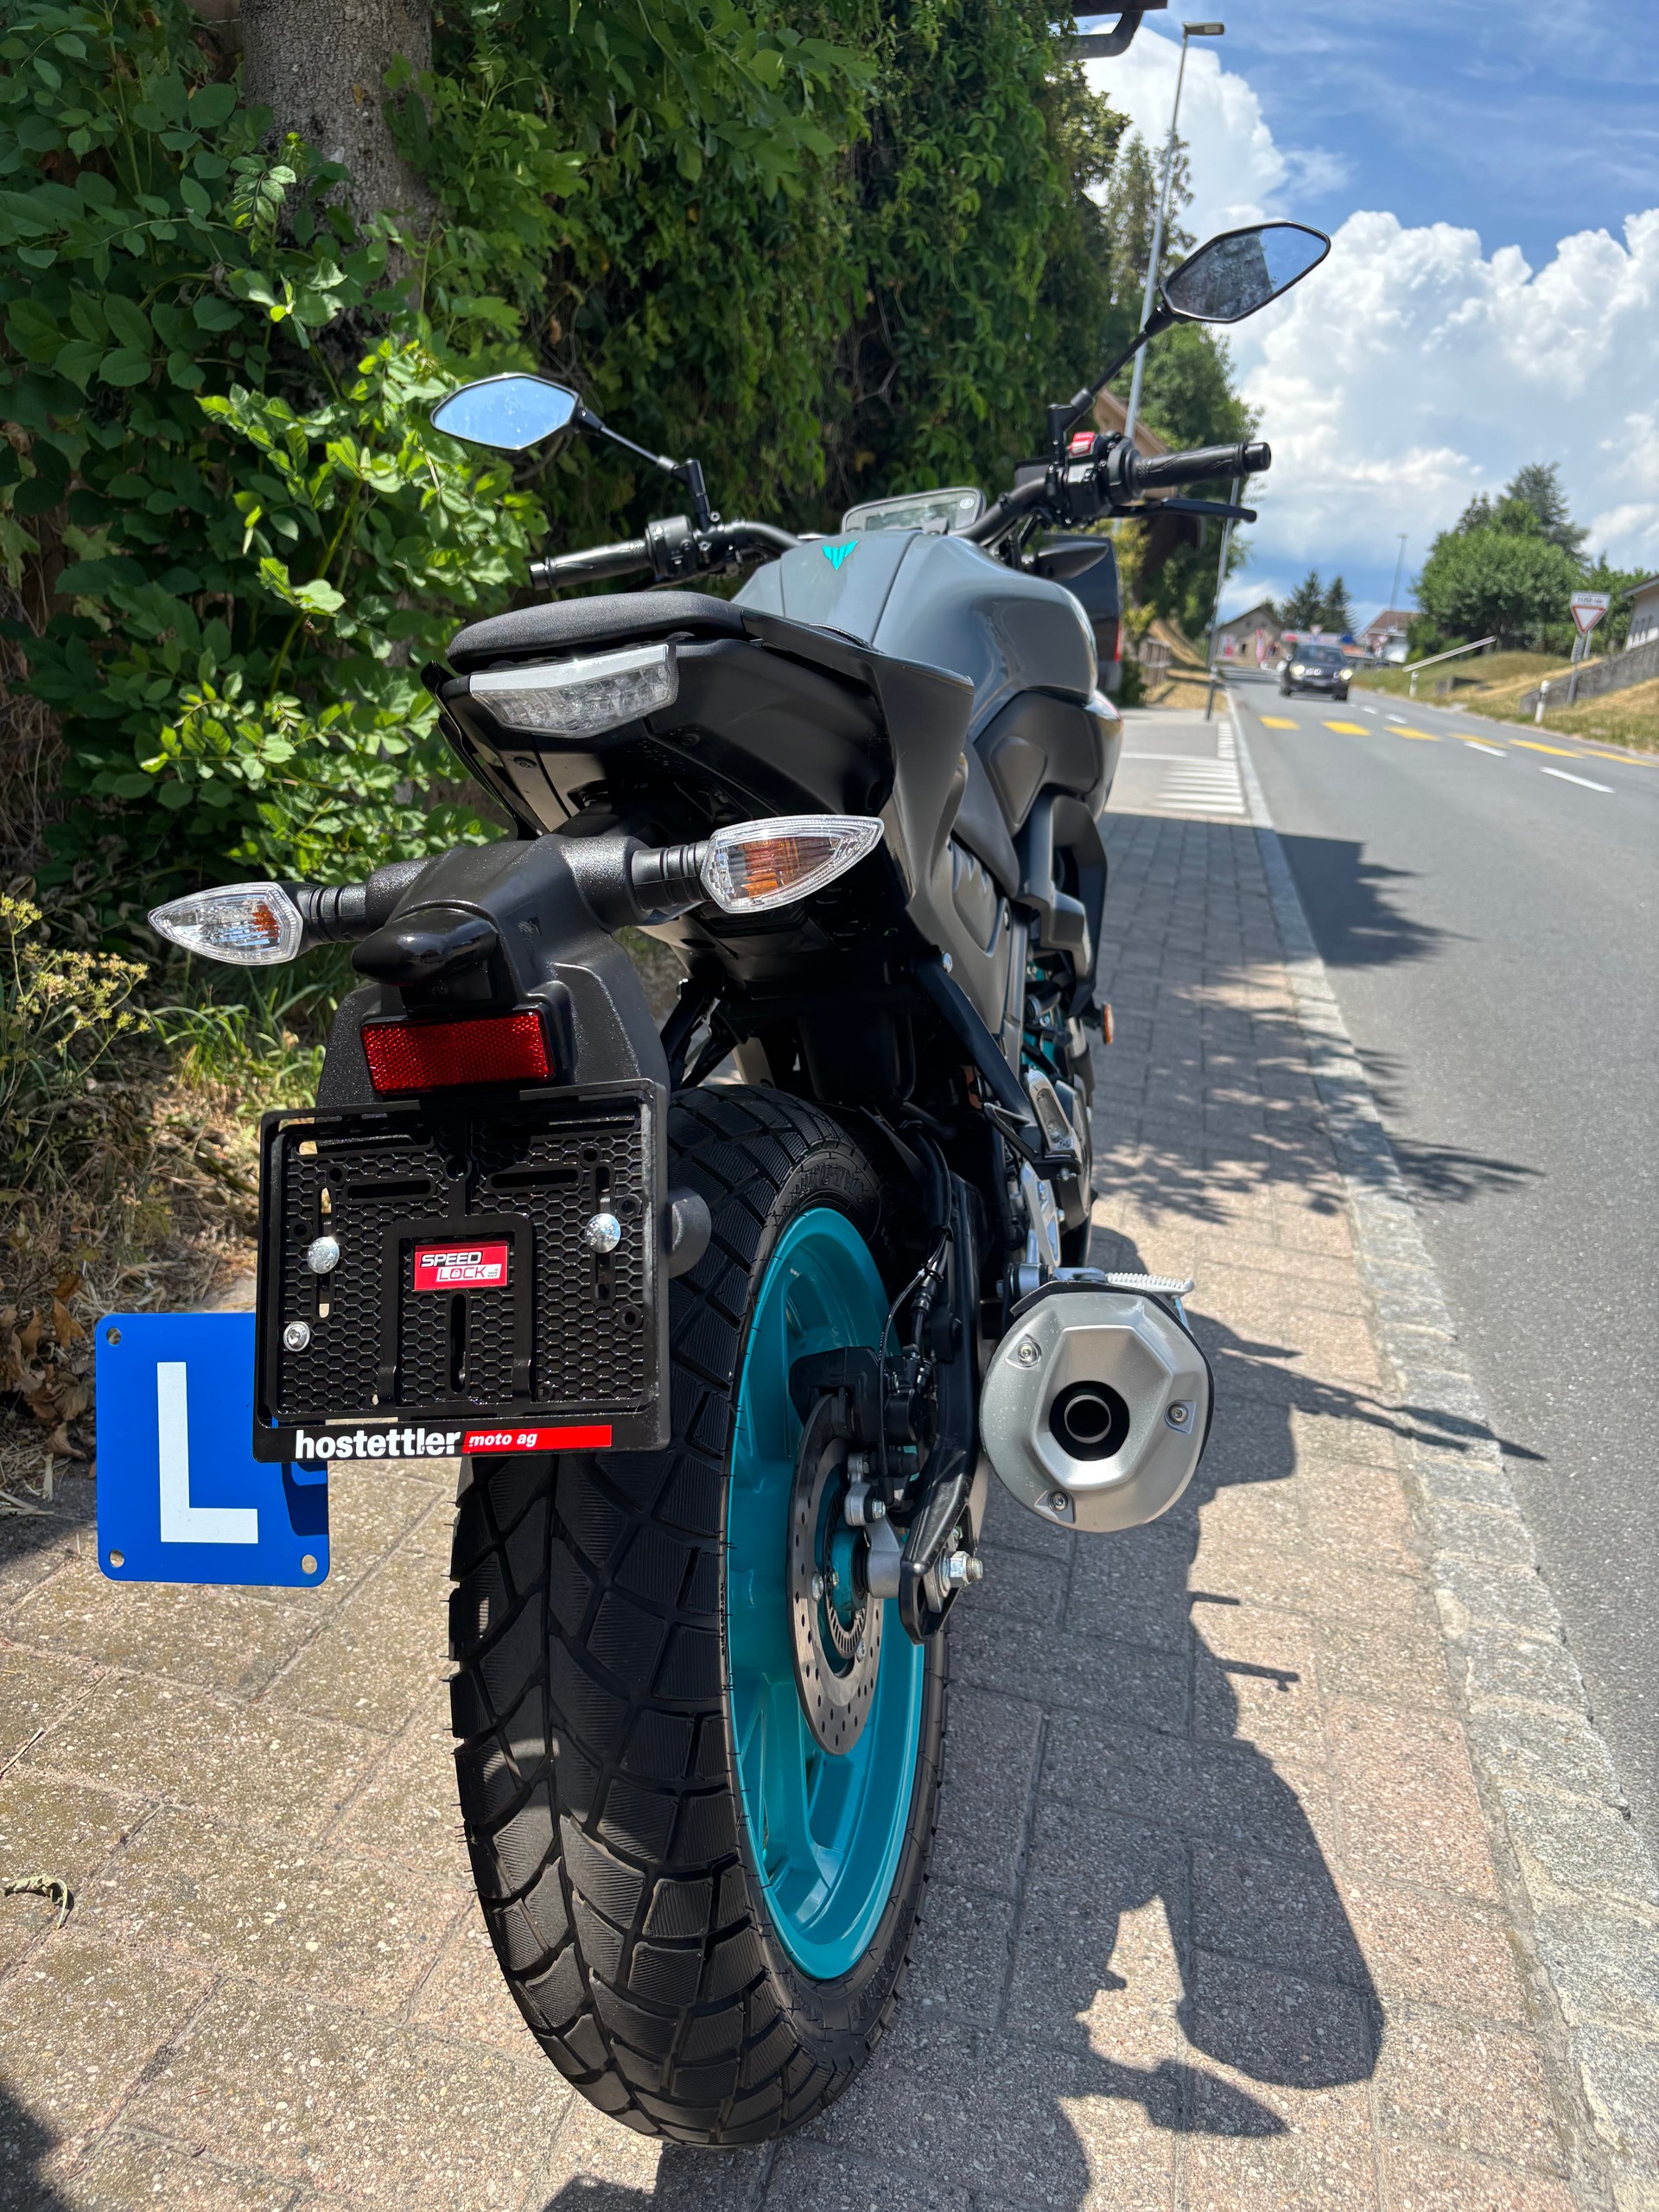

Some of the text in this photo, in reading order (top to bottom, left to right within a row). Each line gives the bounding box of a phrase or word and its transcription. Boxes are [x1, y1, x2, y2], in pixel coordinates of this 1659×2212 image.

[421, 1251, 482, 1268] SPEED
[439, 1266, 486, 1280] LOCK
[156, 1362, 259, 1544] L
[296, 1428, 538, 1459] hostettler moto ag
